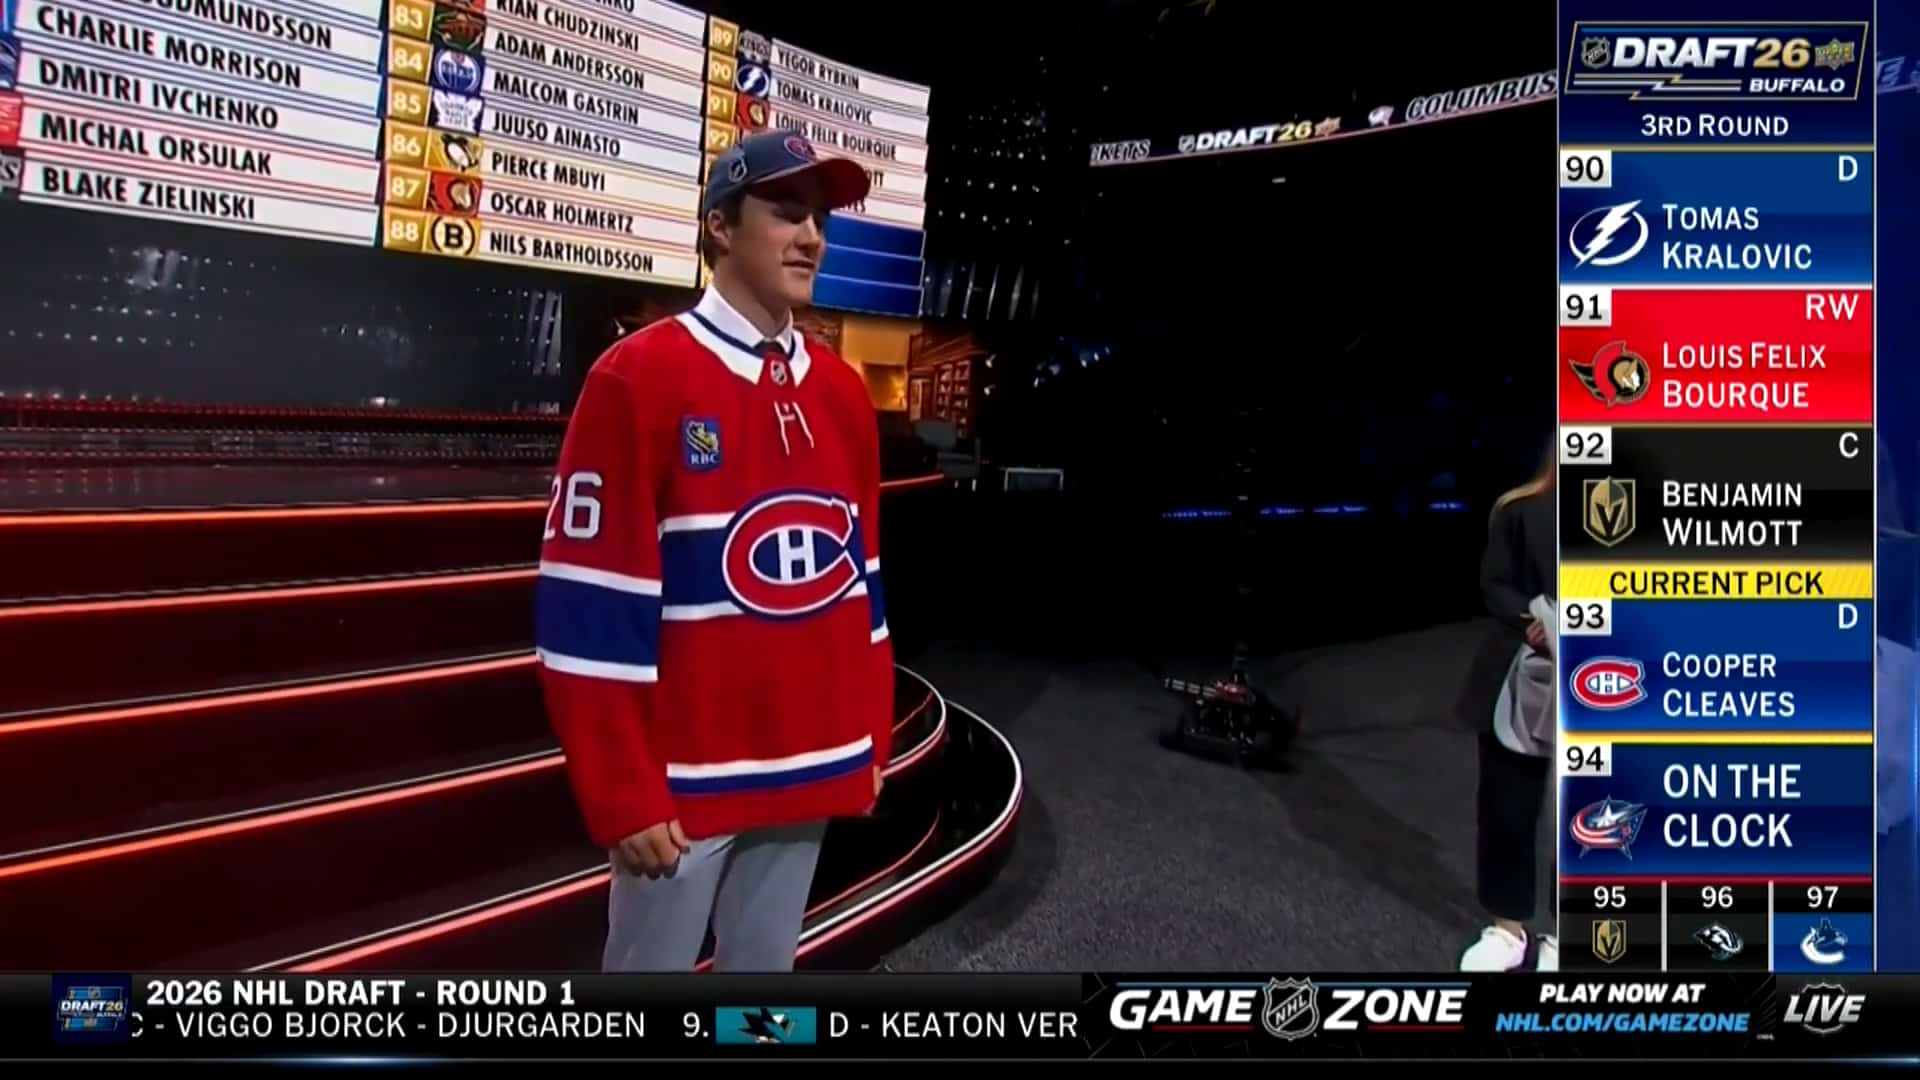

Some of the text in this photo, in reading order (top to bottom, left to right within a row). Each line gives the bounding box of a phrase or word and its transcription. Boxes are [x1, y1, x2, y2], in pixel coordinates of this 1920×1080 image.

[37, 6, 302, 89] CHARLIE MORRISON
[394, 7, 645, 90] 83 ADAM ANDERSSON
[544, 8, 640, 52] CHUDZINSKI
[713, 26, 732, 47] 89
[778, 49, 815, 75] YEGOR
[39, 58, 279, 129] DMITRI IVCHENKO
[394, 46, 424, 72] 84
[493, 71, 568, 108] MALCOM
[573, 95, 640, 126] GASTRIN
[711, 62, 873, 126] 90 TOMAS KRALOVIC
[1405, 70, 1557, 123] COLUMBUS
[41, 113, 149, 156] MICHAL
[159, 135, 272, 177] ORSULAK
[393, 91, 423, 115] 85
[491, 112, 549, 141] JUUSO
[553, 127, 621, 158] AINASTO
[710, 96, 729, 114] 91
[811, 124, 838, 146] FELIX
[842, 132, 897, 160] BOURQUE
[710, 129, 730, 147] 92
[42, 166, 128, 202] BLAKE
[138, 182, 255, 220] ZIELINSKI
[391, 133, 606, 192] 86 PIERCE MBUYI
[391, 177, 634, 234] 87 OSCAR HOLMERTZ
[390, 220, 653, 274] 88 NILS BARTHOLDSSON
